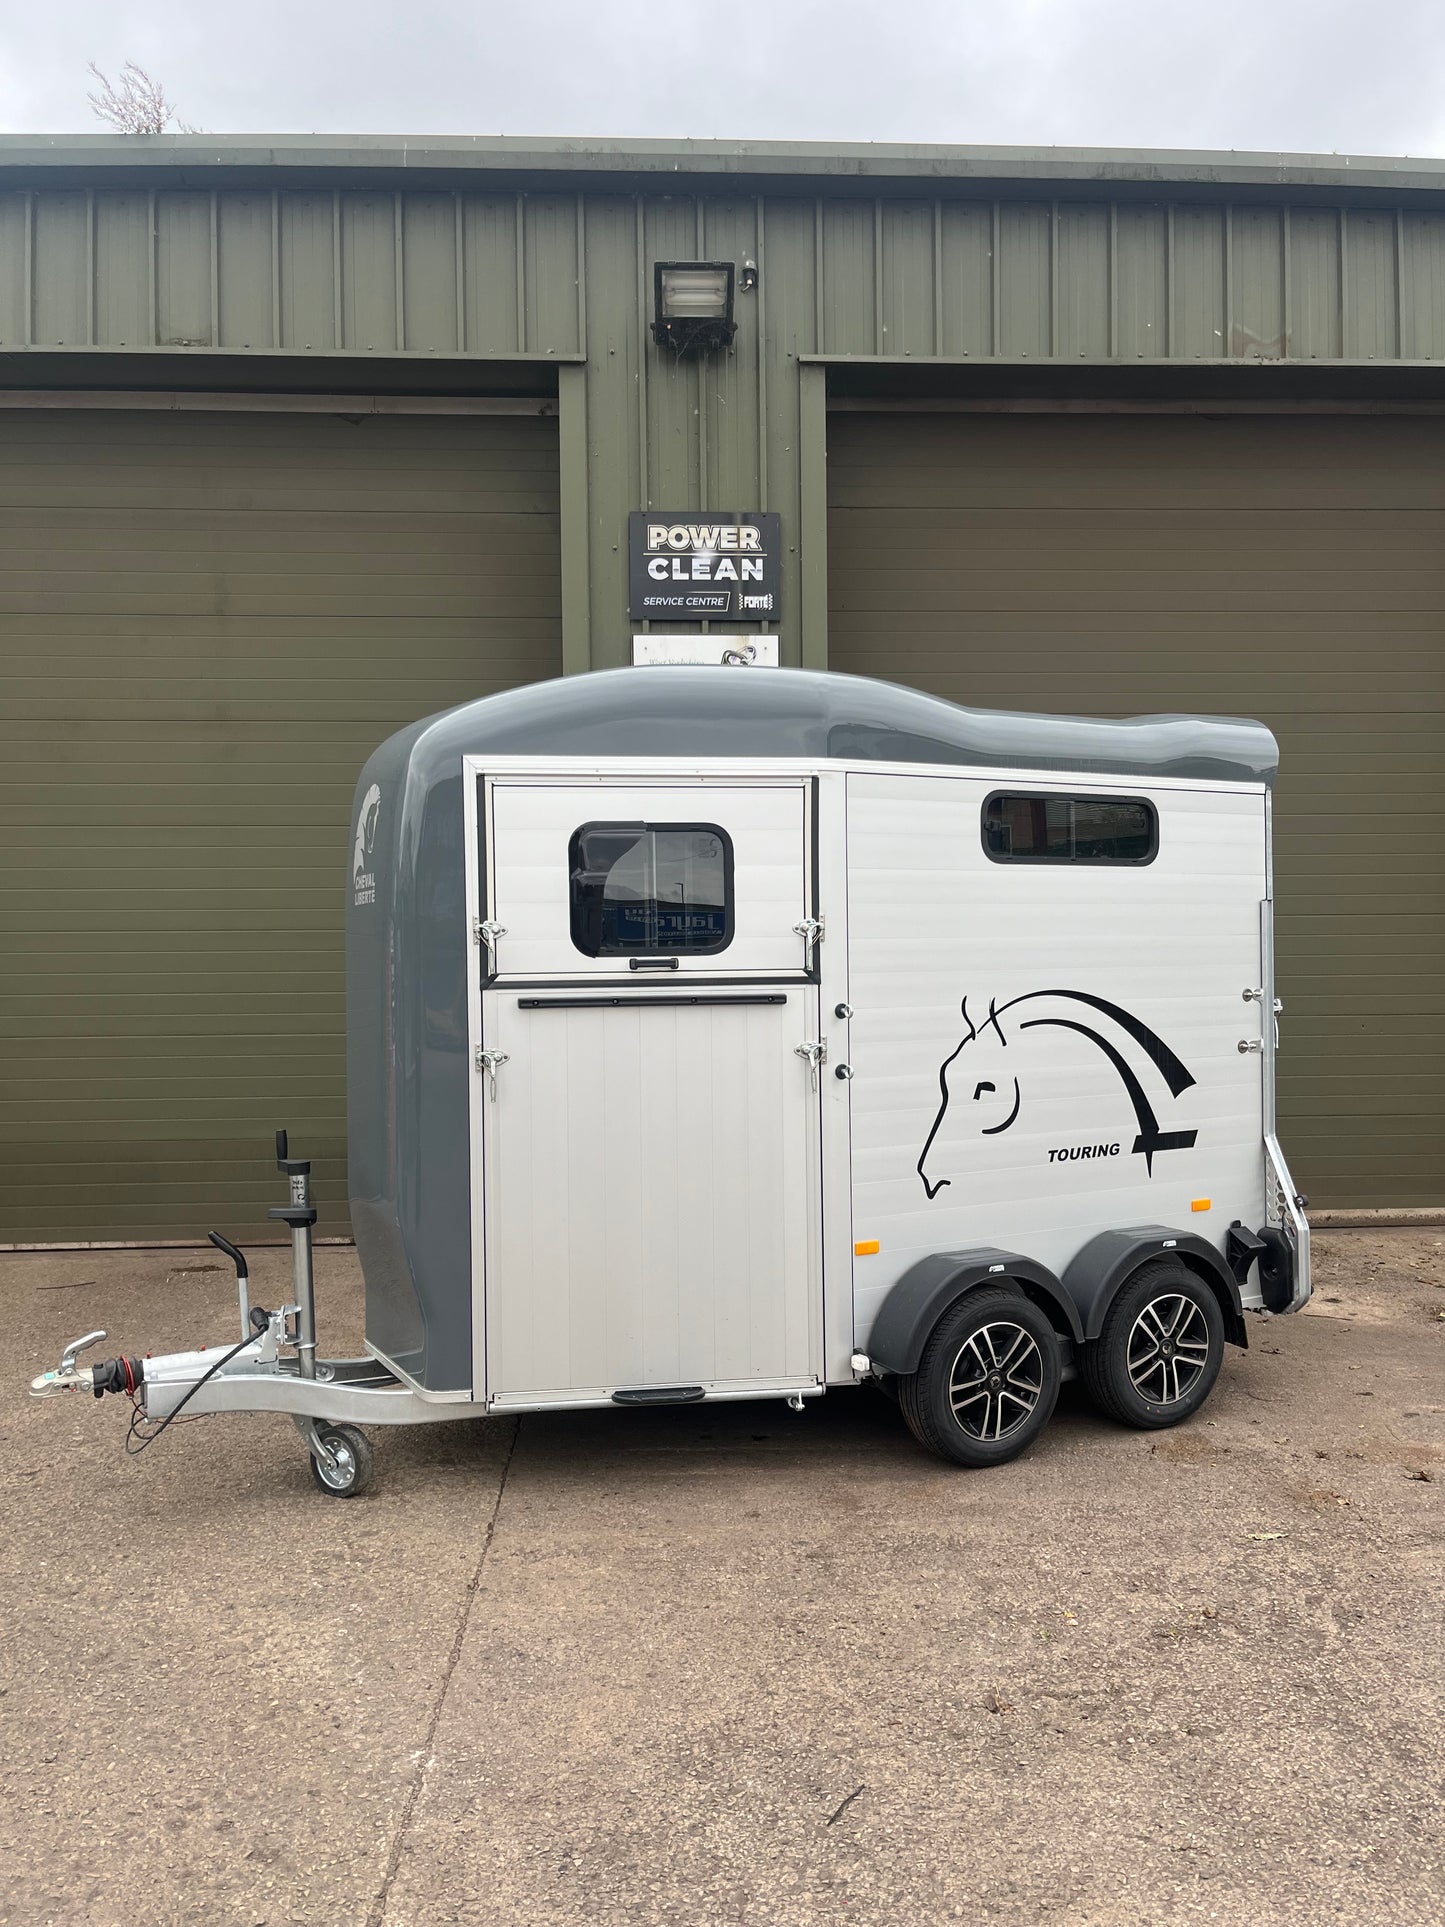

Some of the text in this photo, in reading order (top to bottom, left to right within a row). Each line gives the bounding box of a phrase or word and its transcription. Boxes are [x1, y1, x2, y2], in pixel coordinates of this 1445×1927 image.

[647, 525, 763, 551] POWER
[647, 557, 764, 581] CLEAN
[643, 597, 725, 606] SERVICE CENTRE
[355, 872, 376, 890] CHEVAL
[1048, 1143, 1121, 1163] TOURING
